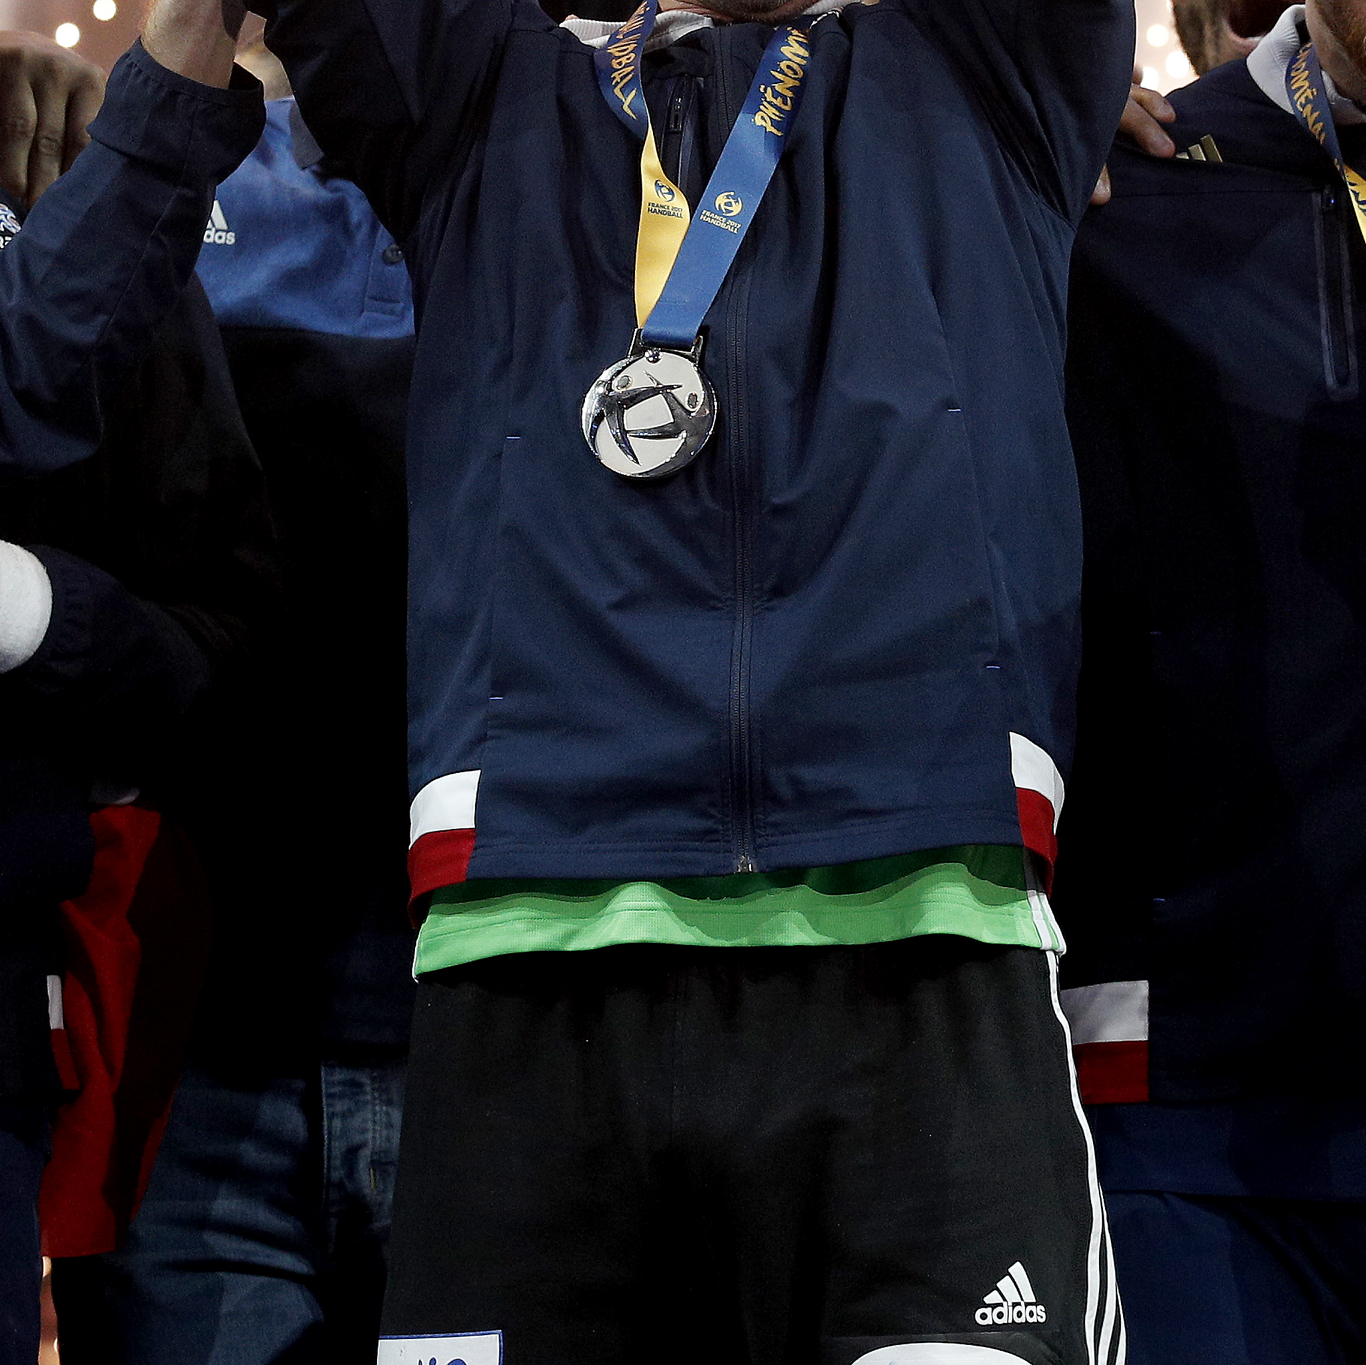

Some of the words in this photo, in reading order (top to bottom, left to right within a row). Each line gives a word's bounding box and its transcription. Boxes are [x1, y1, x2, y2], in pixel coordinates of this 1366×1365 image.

[752, 26, 810, 136] PHÉNOM
[699, 215, 739, 234] HANDBALL
[203, 227, 236, 245] das
[975, 1301, 1047, 1326] adidas
